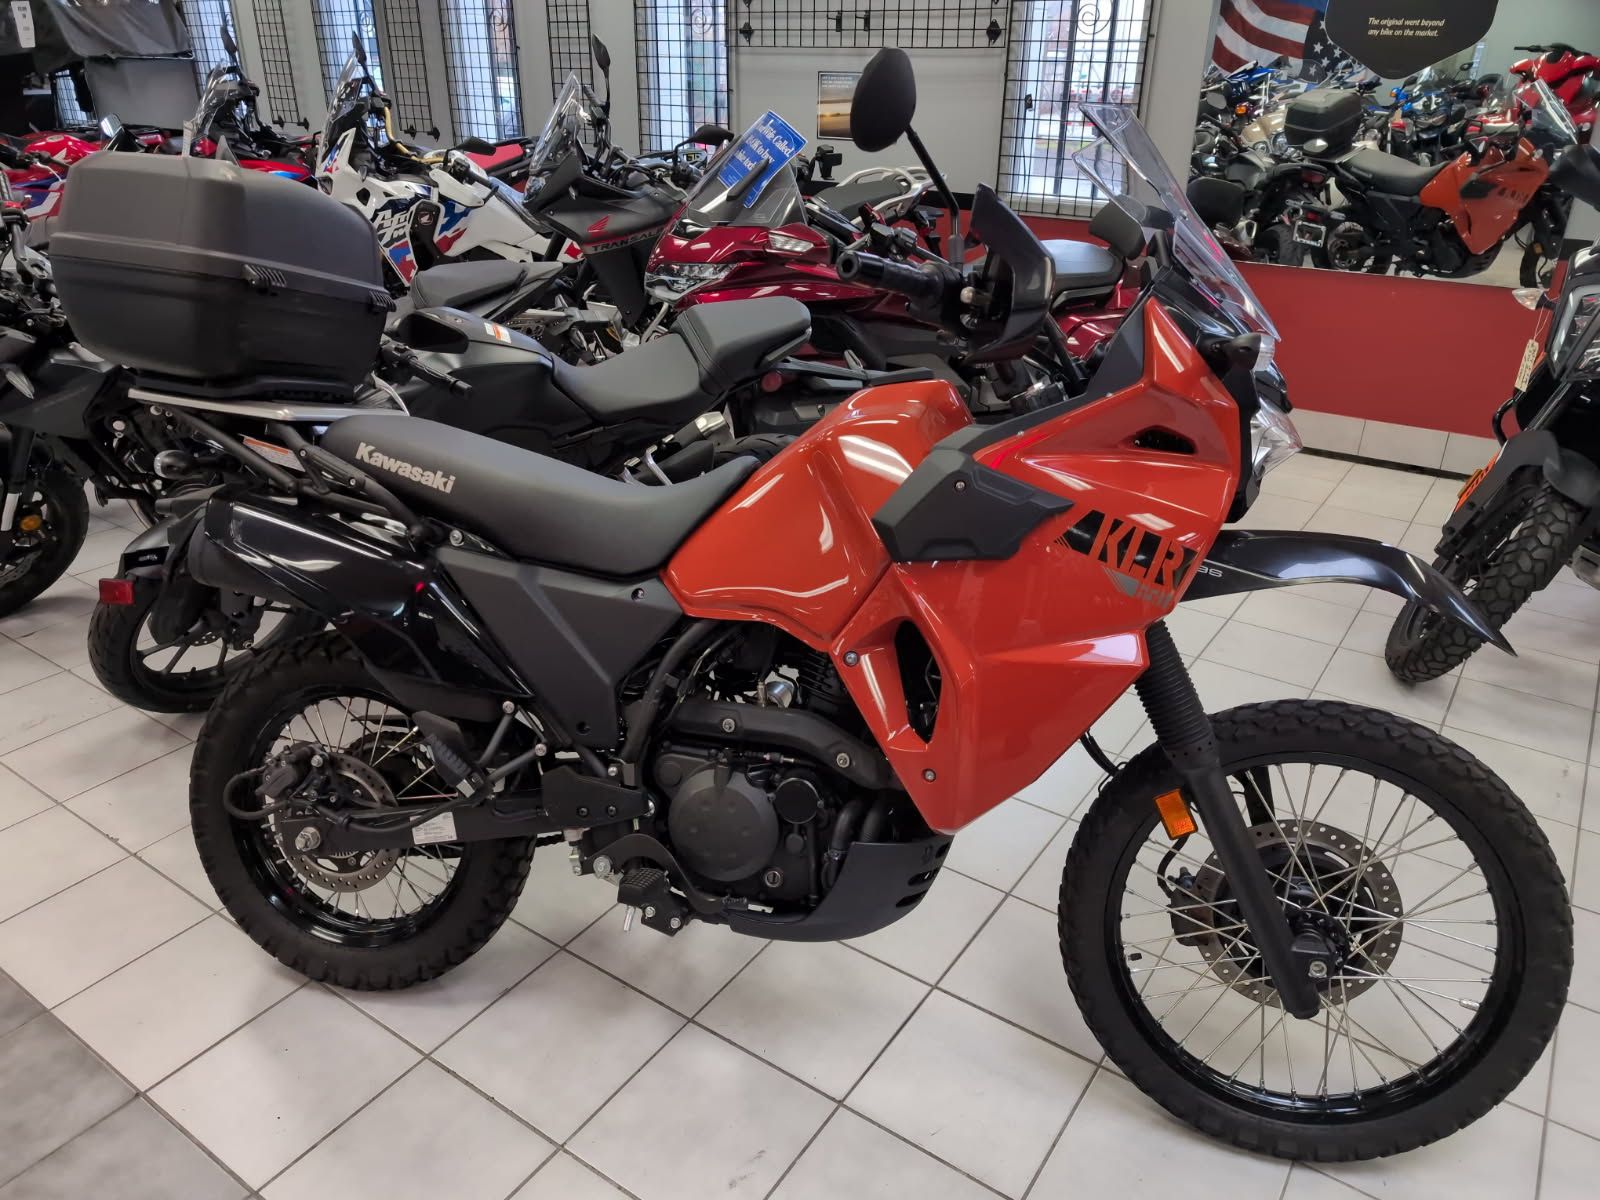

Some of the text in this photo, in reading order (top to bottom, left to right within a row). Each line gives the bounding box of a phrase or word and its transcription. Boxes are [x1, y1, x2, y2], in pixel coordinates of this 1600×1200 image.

[1368, 17, 1380, 25] The
[1380, 18, 1404, 27] original
[1421, 19, 1445, 28] beyond
[1380, 28, 1393, 36] bike
[1403, 28, 1414, 36] the
[1415, 29, 1439, 37] market.
[355, 441, 457, 494] Kawasaki
[1089, 512, 1186, 592] KLR
[1197, 564, 1223, 578] BS
